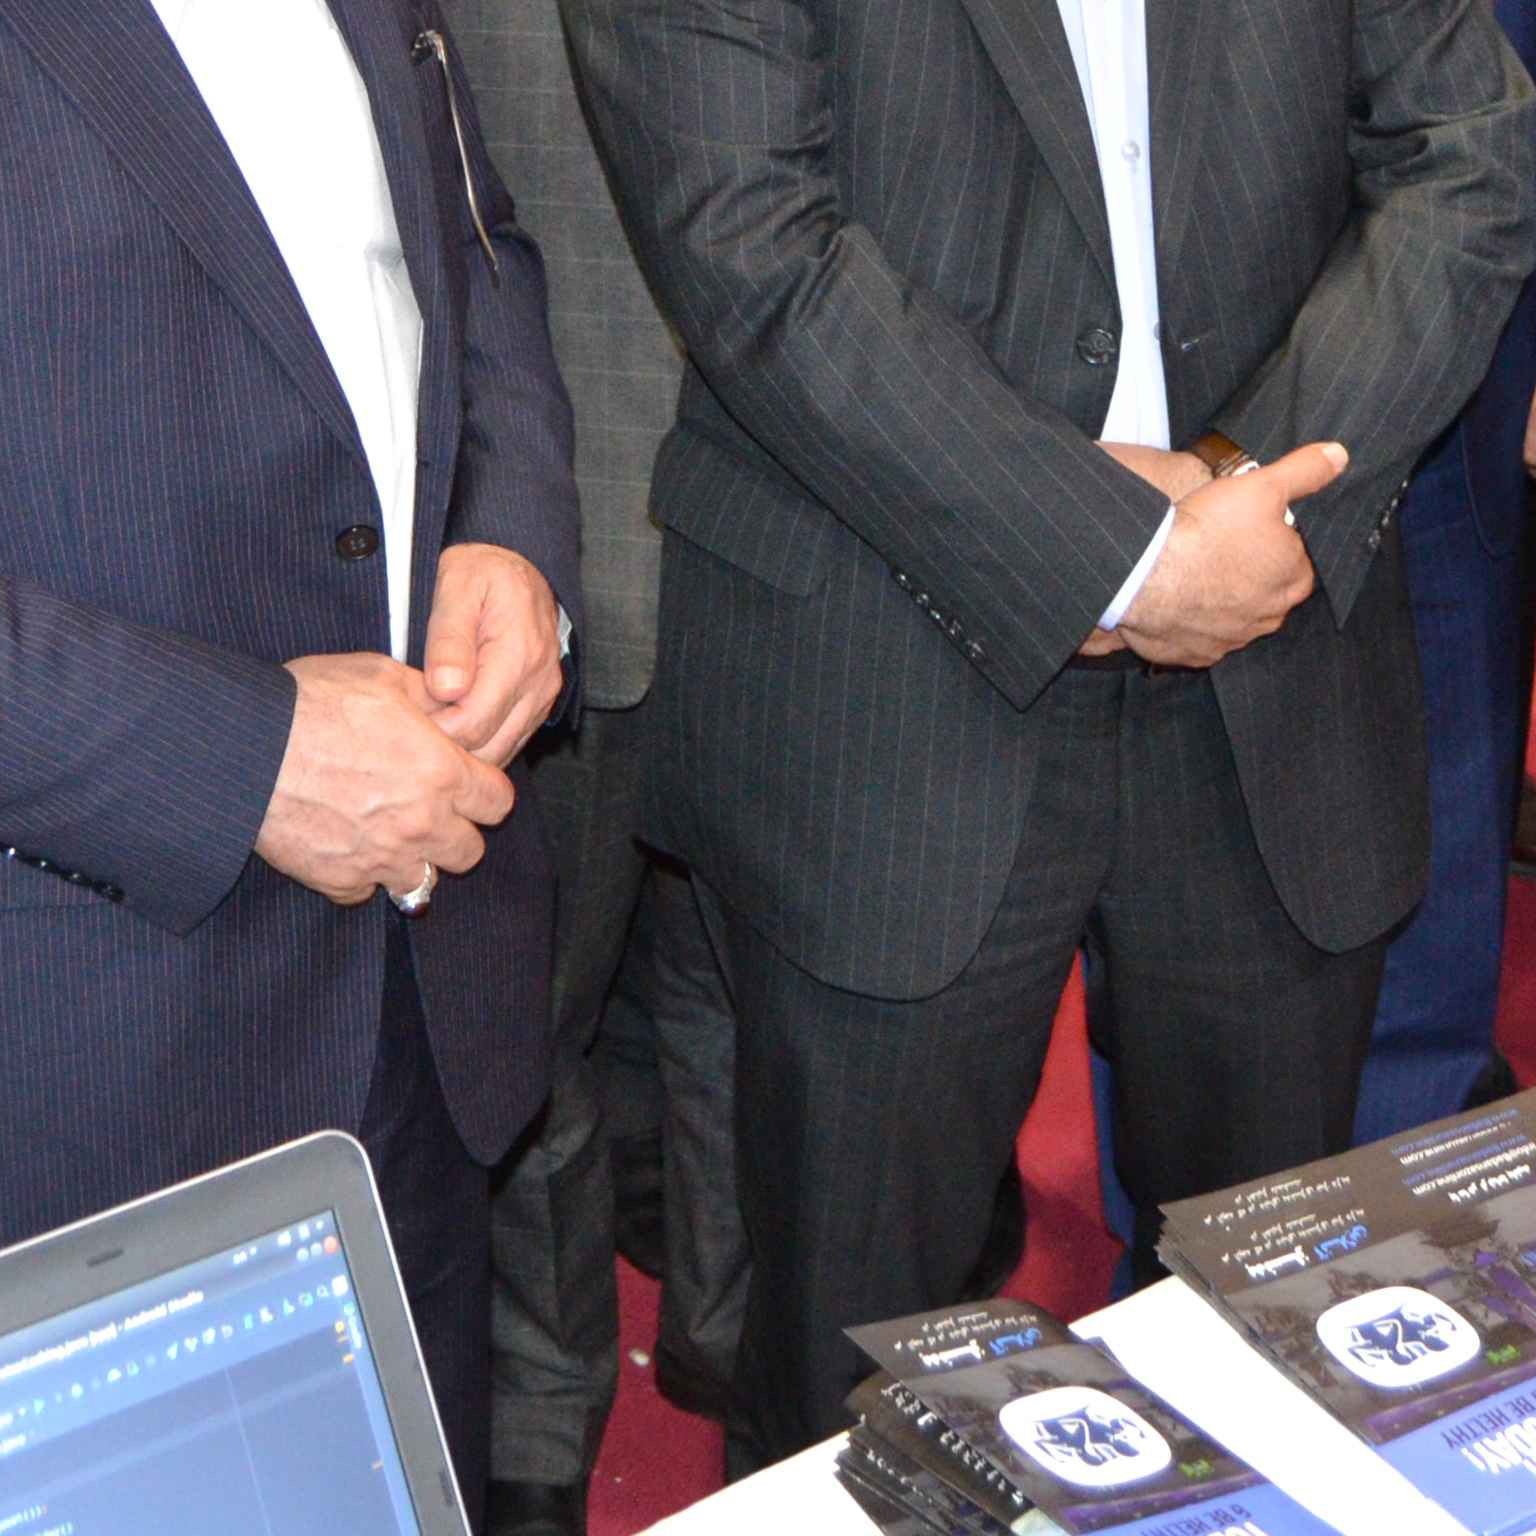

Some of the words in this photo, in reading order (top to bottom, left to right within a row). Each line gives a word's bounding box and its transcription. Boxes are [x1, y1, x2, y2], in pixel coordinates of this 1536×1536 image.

[1243, 1245, 1313, 1281] بدنساز
[1306, 1225, 1376, 1259] آنلاین
[1503, 1397, 1536, 1418] BE
[1439, 1408, 1510, 1447] HELTHY
